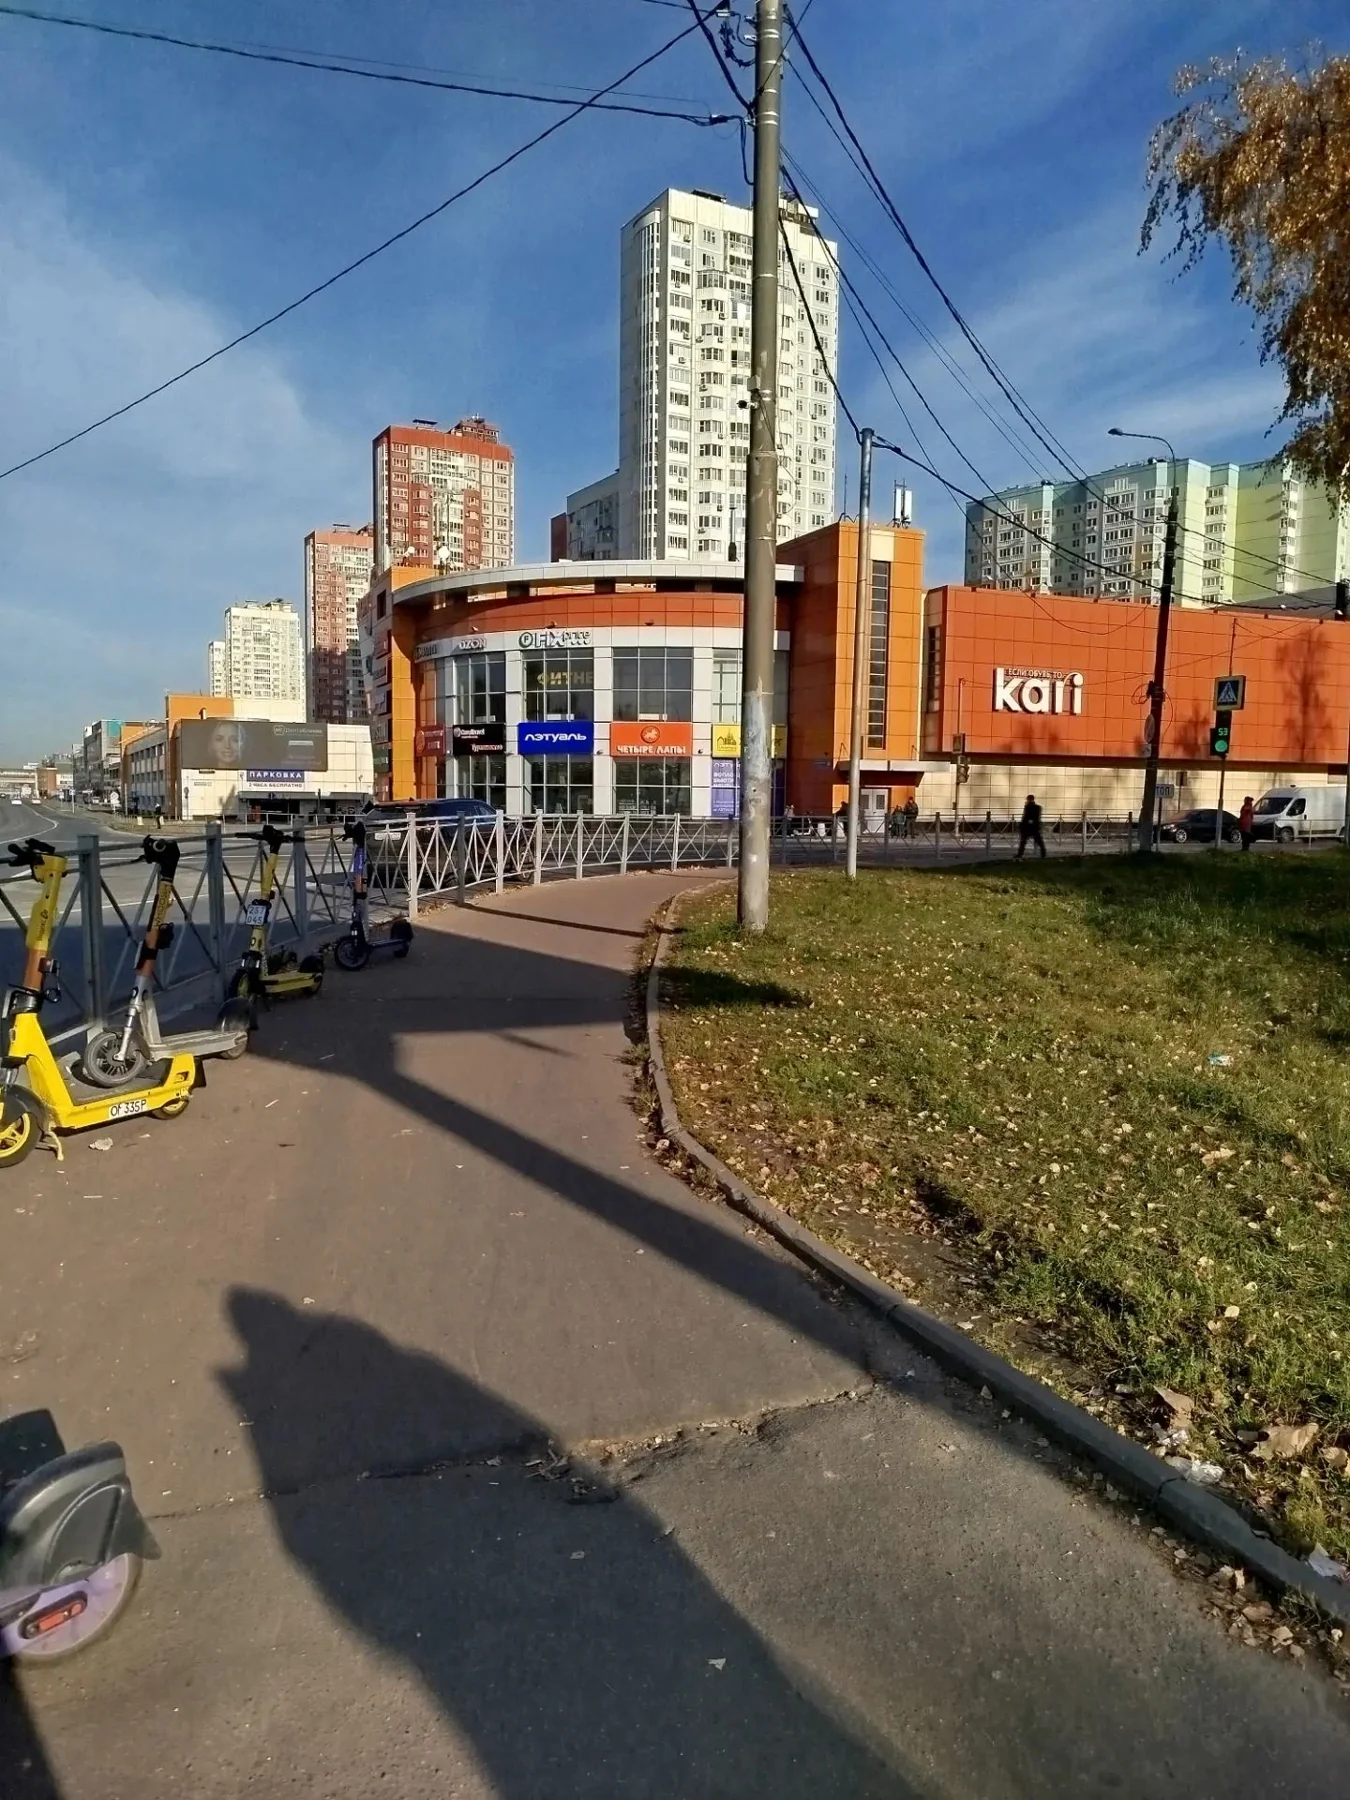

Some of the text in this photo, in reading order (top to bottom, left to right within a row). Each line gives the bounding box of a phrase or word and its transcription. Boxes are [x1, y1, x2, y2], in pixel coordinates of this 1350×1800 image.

[458, 637, 488, 650] OZON
[535, 631, 564, 647] FIX
[1008, 668, 1027, 676] ЕСЛИ
[537, 672, 594, 685] ФИТНЕ
[993, 667, 1084, 715] kari
[1218, 727, 1229, 736] 53
[616, 745, 686, 755] ЧЕТЫРЕ ЛАПЫ
[249, 770, 302, 778] ПАРКОВКА
[1156, 786, 1170, 796] ТОП
